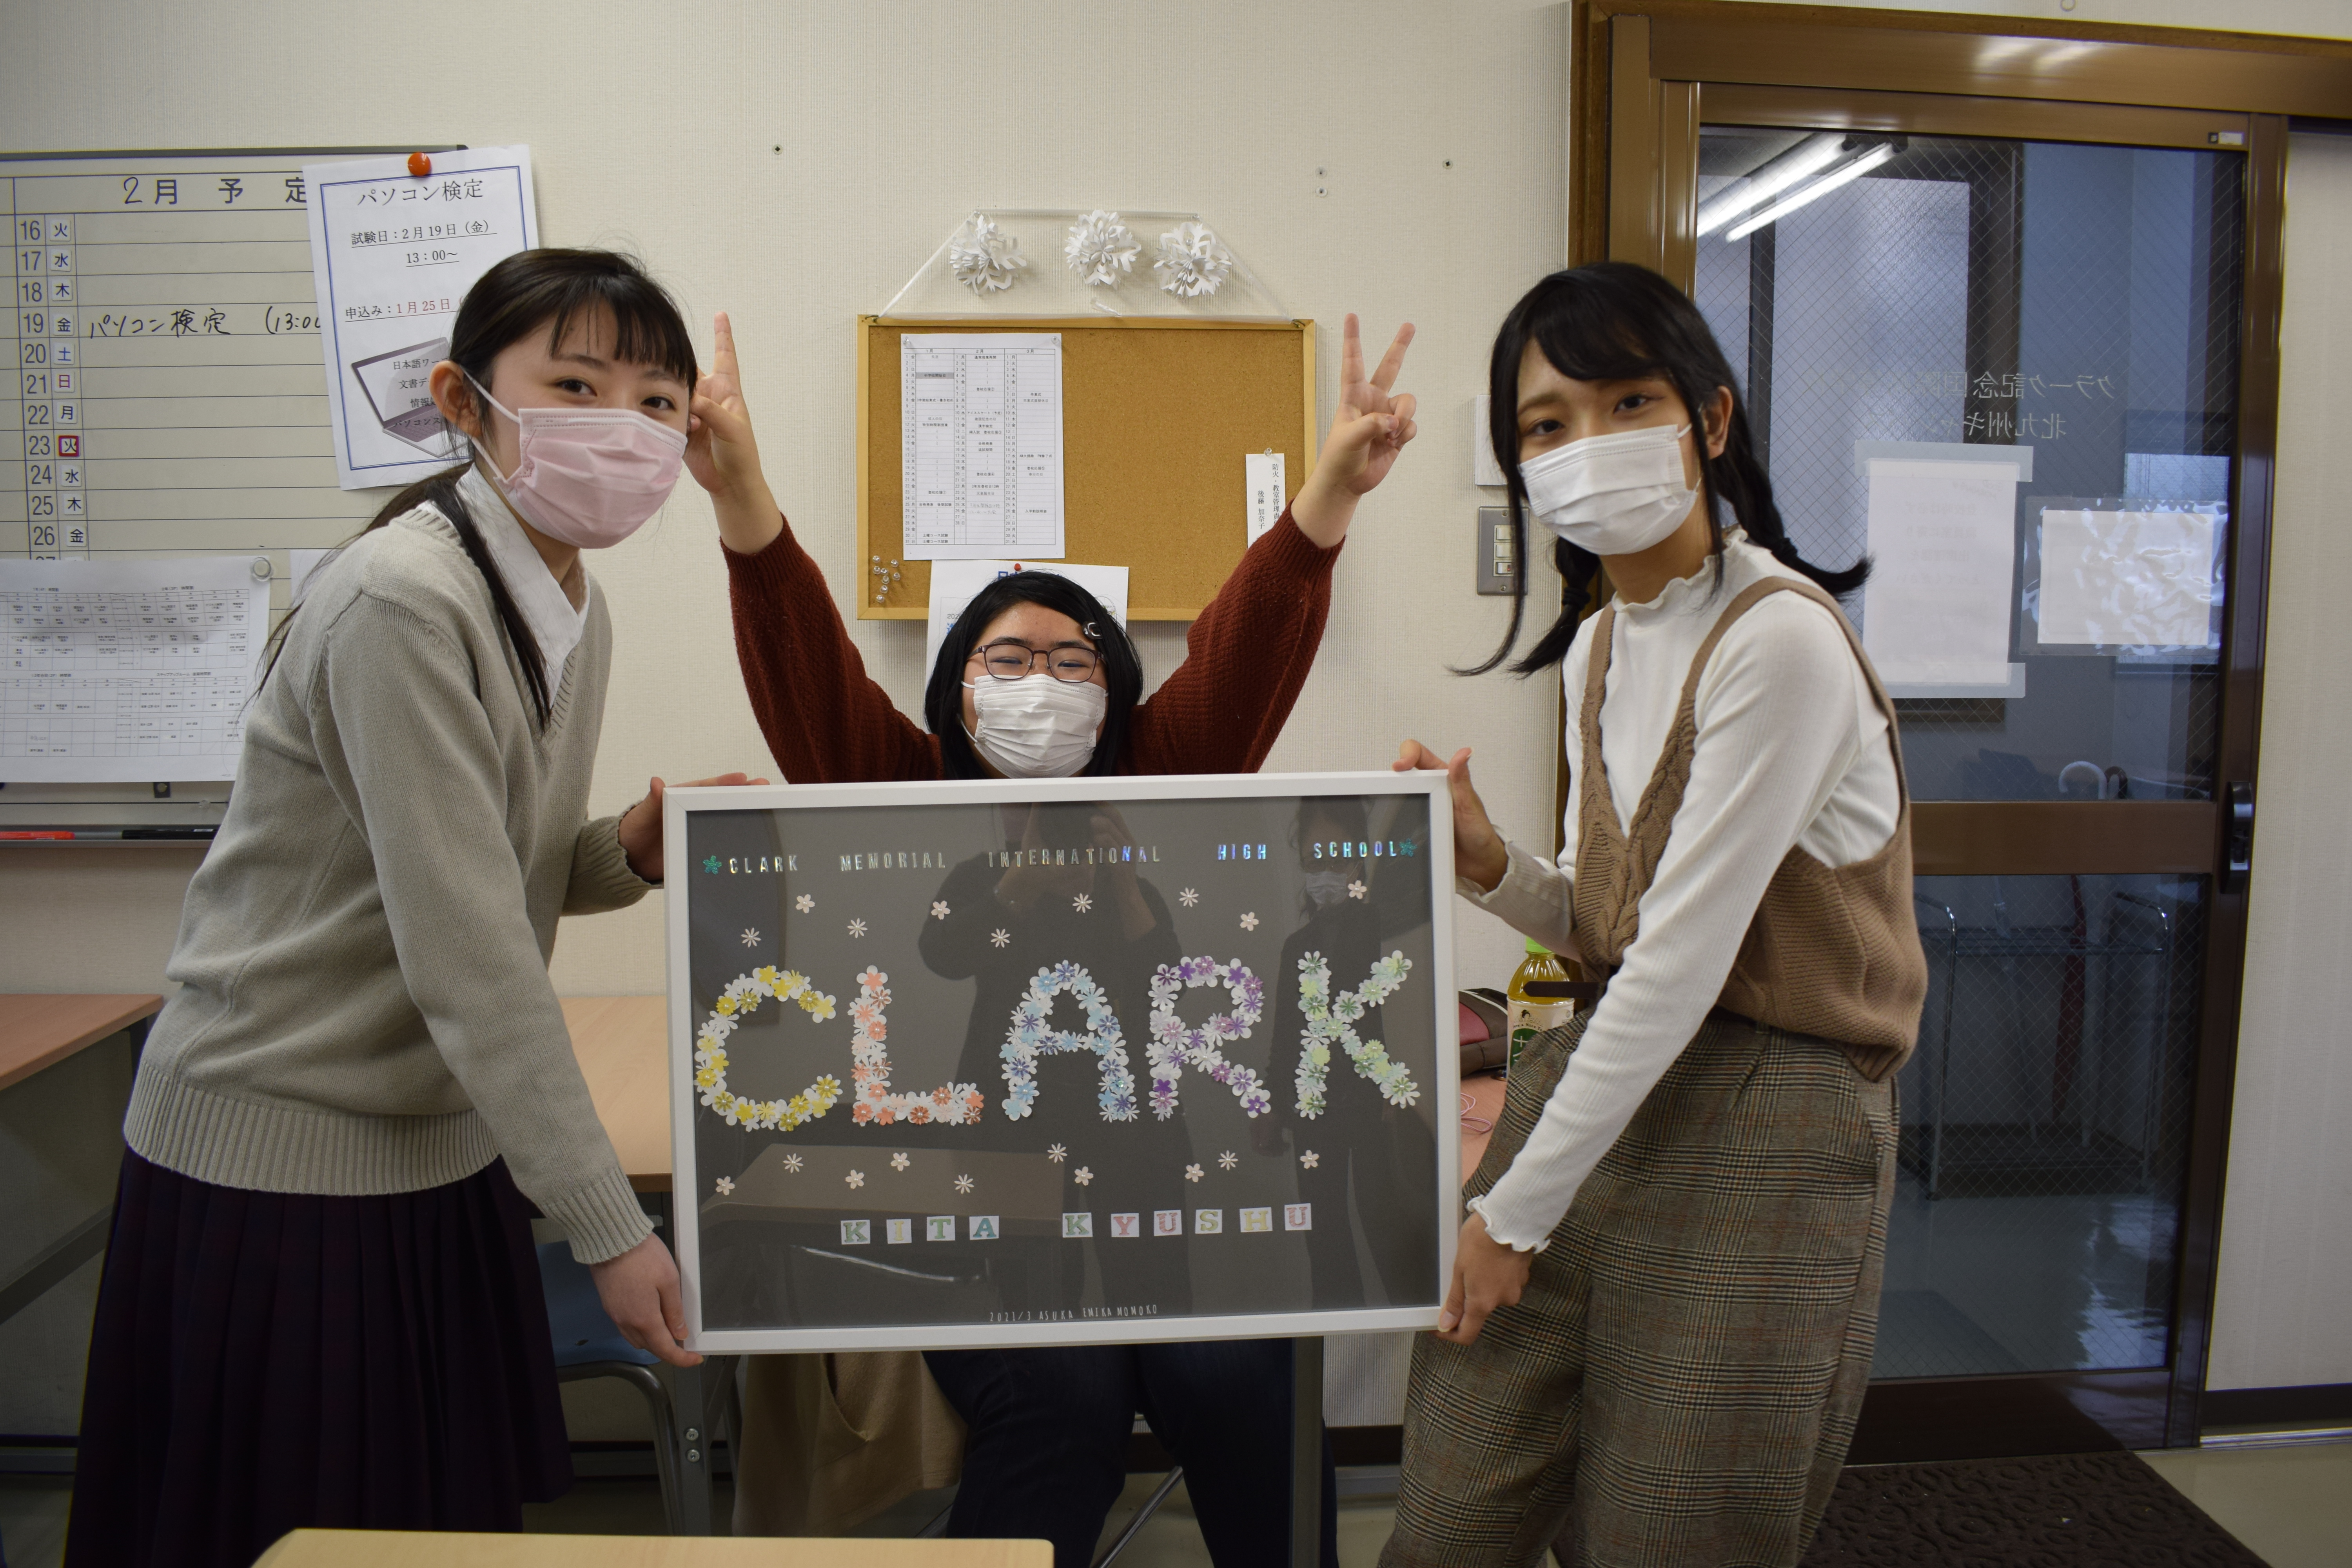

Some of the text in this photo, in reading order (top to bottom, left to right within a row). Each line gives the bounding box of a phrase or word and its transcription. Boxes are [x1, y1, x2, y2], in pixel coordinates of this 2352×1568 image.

[357, 179, 483, 206] パソコン検定
[20, 220, 68, 240] 16 火
[22, 252, 68, 271] 17 水
[22, 283, 70, 301] 18 木
[24, 314, 71, 333] 19 金
[91, 308, 230, 338] パソコン検定
[25, 344, 71, 363] 20 土
[394, 358, 448, 370] 日本語ワー
[27, 375, 70, 394] 21 日
[399, 377, 429, 389] 文書デ
[28, 405, 73, 425] 22 月
[29, 436, 77, 455] 23 火
[31, 465, 79, 484] 24 水
[32, 496, 82, 515] 25 木
[34, 526, 84, 545] 26 金
[730, 840, 1397, 874] CLARK MEMORIAL INTERNATIONAL HIGH SCHOOL
[694, 950, 1421, 1132] CLARK
[843, 1207, 1308, 1243] KITA KYUSHU
[990, 1304, 1157, 1322] 2021/3 ASUKA EMIKA MOMOKO
